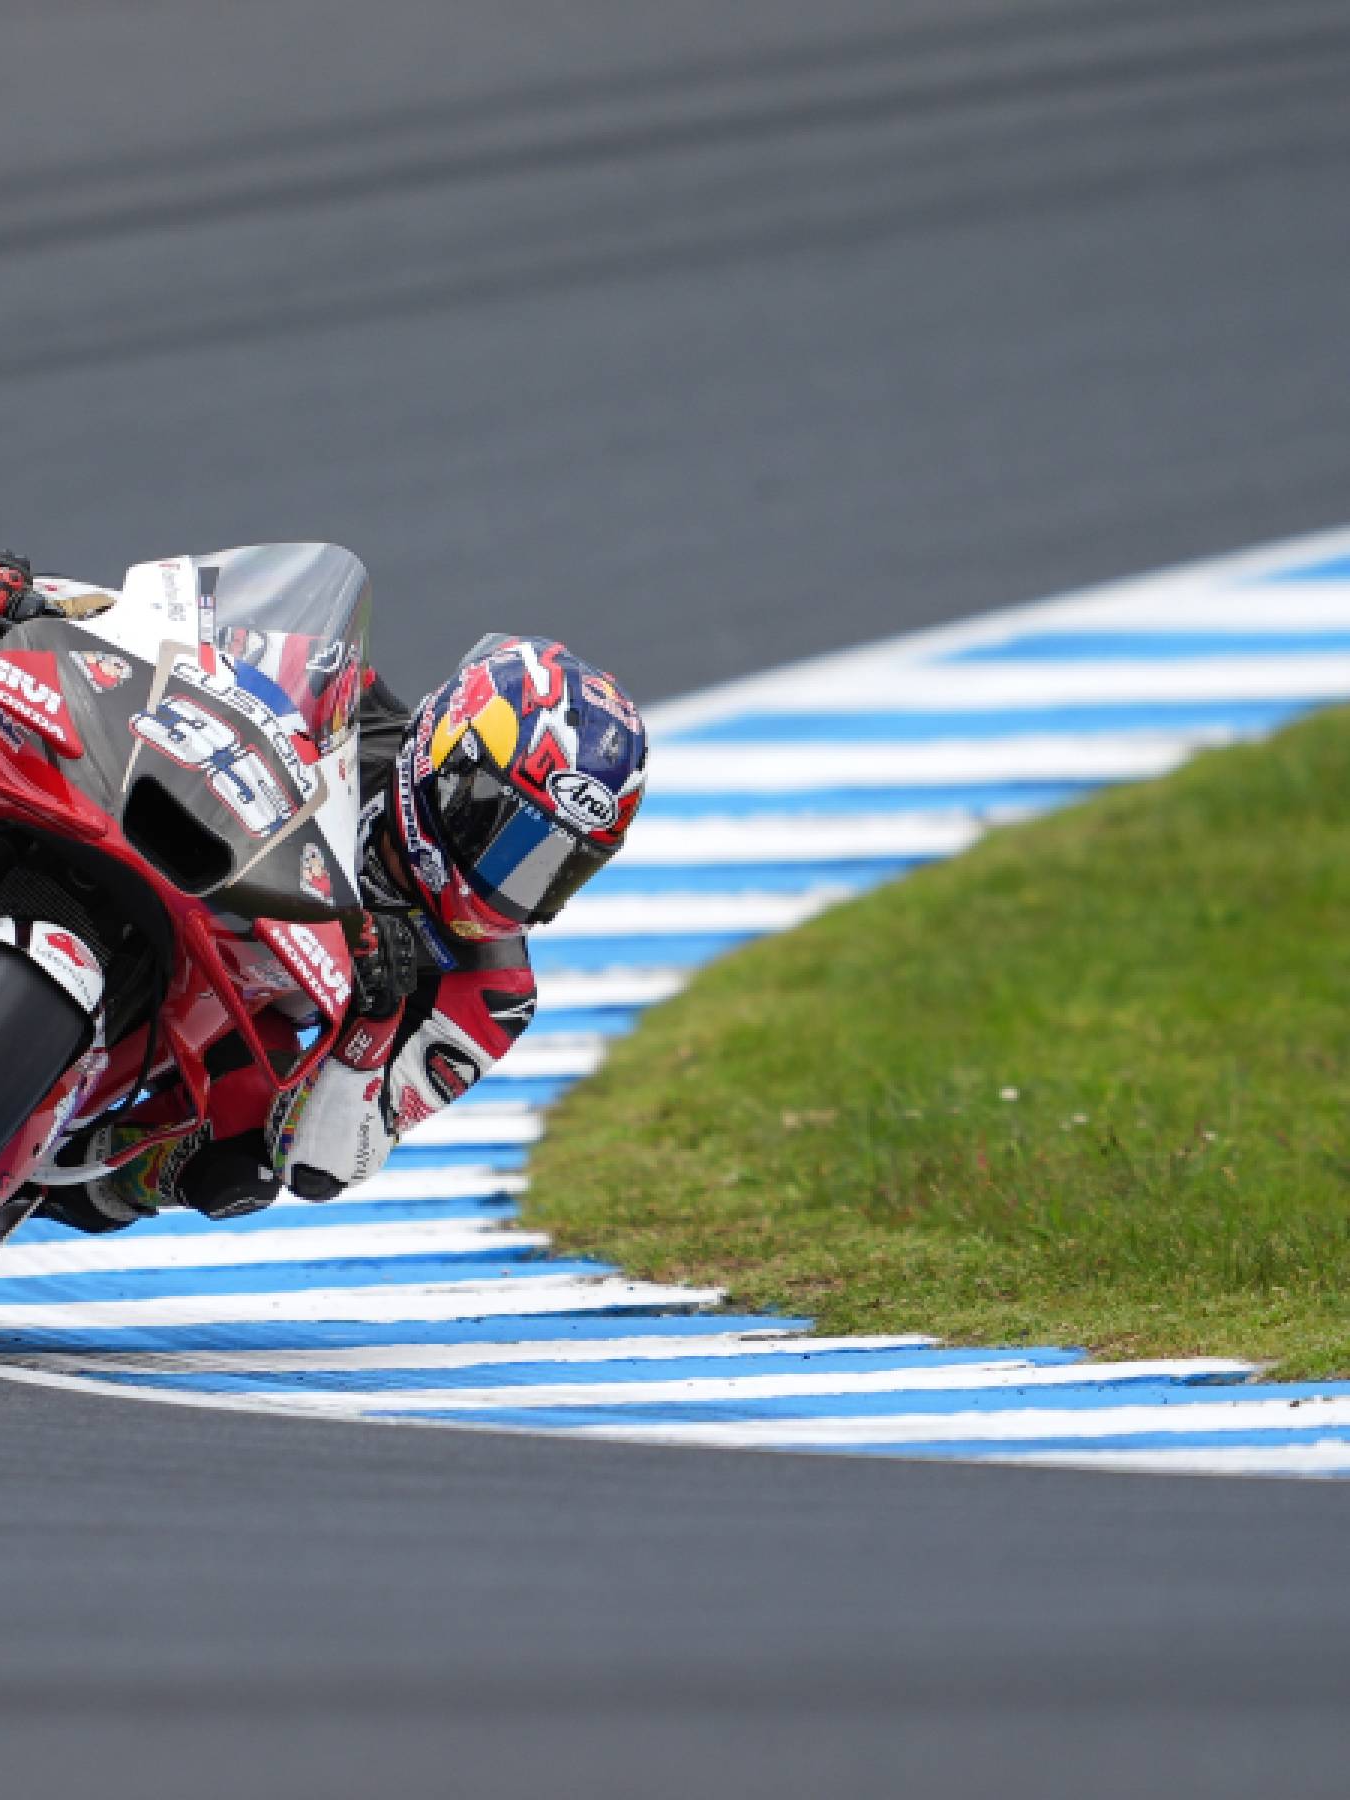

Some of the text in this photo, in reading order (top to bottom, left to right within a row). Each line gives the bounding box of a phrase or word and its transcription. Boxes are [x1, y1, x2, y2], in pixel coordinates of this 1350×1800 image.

[129, 695, 298, 839] 35
[173, 662, 313, 794] CUSTOM
[557, 784, 611, 820] Arai
[271, 928, 335, 1014] HONDA
[288, 922, 352, 1004] GIVI
